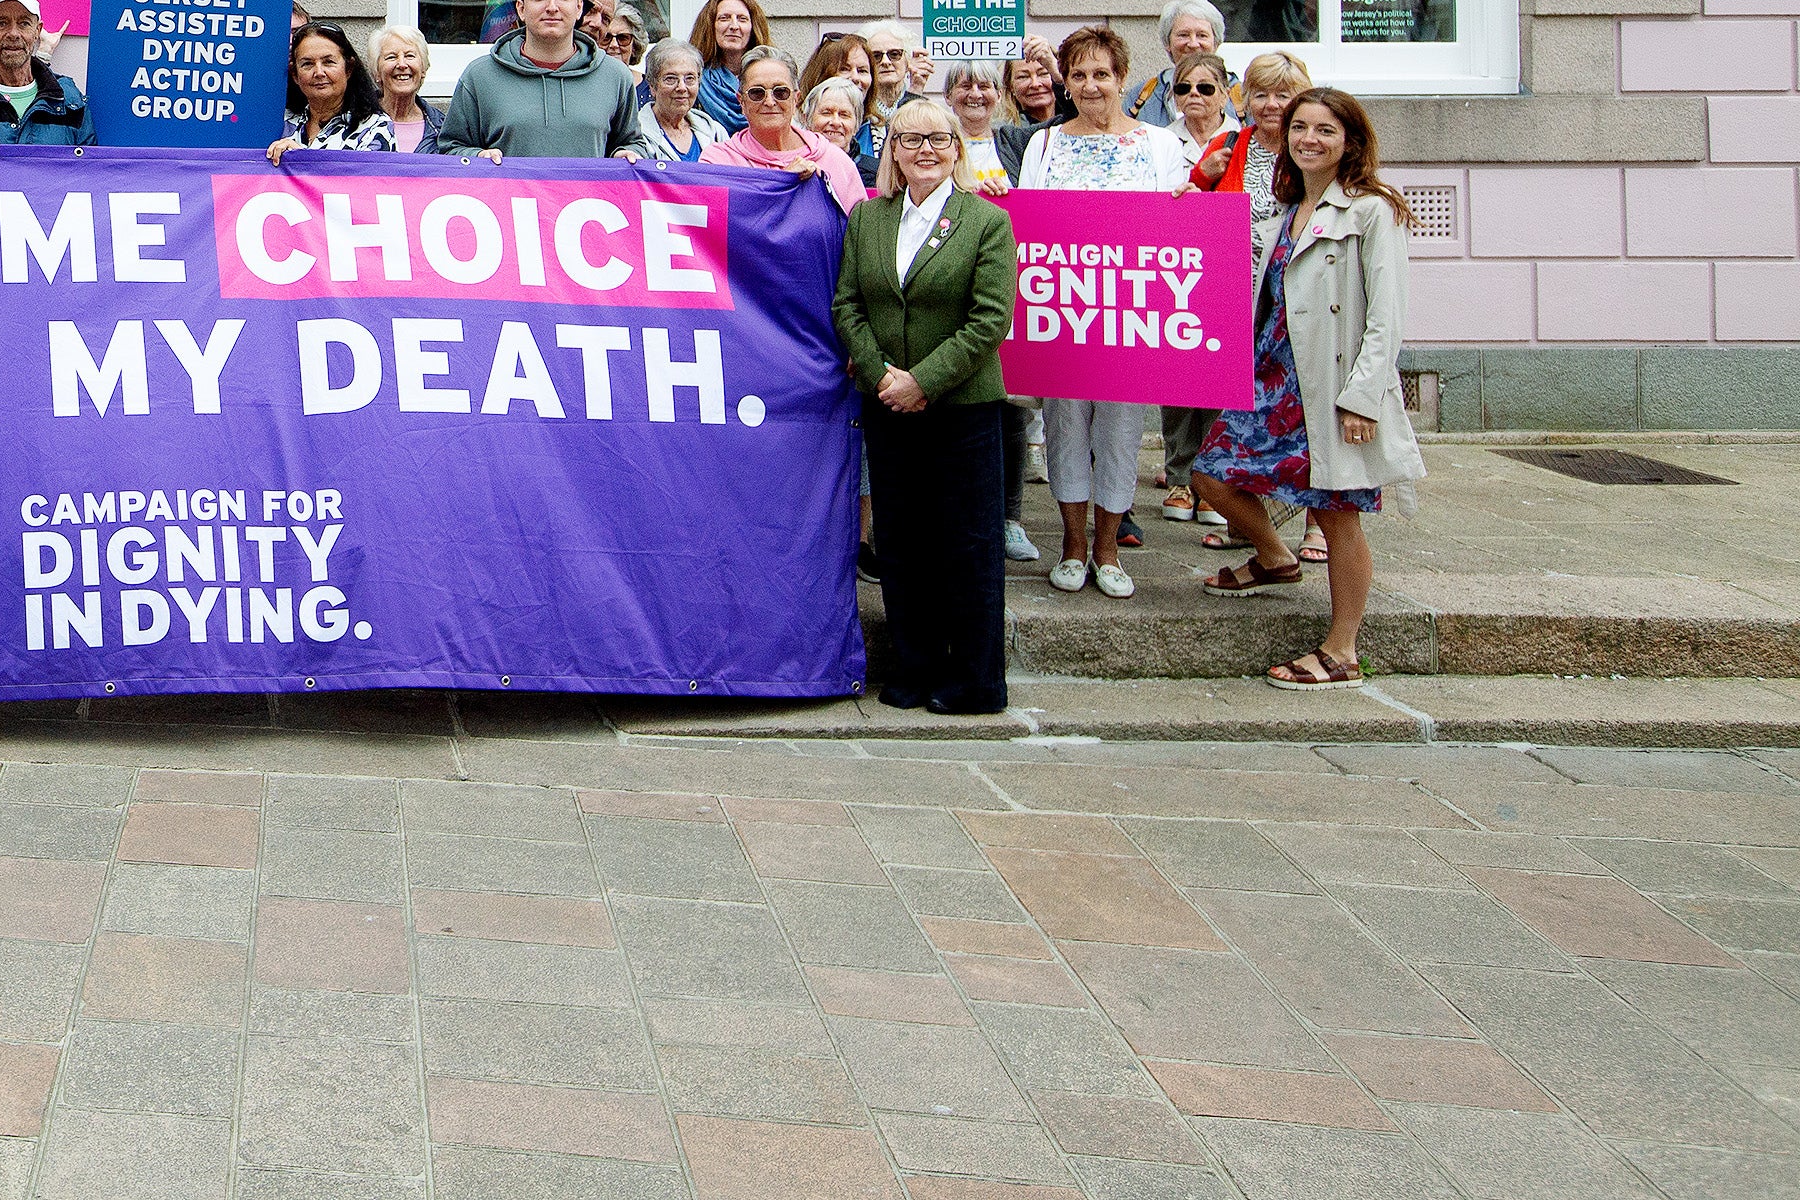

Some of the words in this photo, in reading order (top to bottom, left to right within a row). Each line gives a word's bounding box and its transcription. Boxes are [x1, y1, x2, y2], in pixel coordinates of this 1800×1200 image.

[116, 8, 265, 38] ASSISTED
[932, 15, 1016, 33] CHOICE
[1342, 10, 1353, 18] ow
[1383, 9, 1413, 19] political
[1352, 19, 1374, 27] works
[1375, 19, 1389, 27] and
[1389, 19, 1406, 27] how
[1406, 19, 1415, 27] to
[1341, 28, 1353, 36] ake
[1354, 28, 1360, 36] it
[1360, 28, 1379, 36] work
[1379, 28, 1390, 36] for
[142, 38, 236, 65] DYING
[932, 41, 999, 56] ROUTE
[1006, 41, 1017, 56] 2
[130, 67, 243, 94] ACTION
[131, 95, 239, 123] GROUP.
[234, 191, 717, 293] CHOICE
[1137, 246, 1203, 270] FOR
[1018, 266, 1203, 310] GNITY
[1026, 306, 1221, 352] DYING.
[47, 318, 247, 419] MY
[297, 317, 767, 428] DEATH.
[21, 488, 246, 527] CAMPAIGN
[262, 488, 343, 522] FOR
[22, 523, 345, 589] DIGNITY
[24, 590, 103, 651] IN
[120, 585, 373, 647] DYING.
